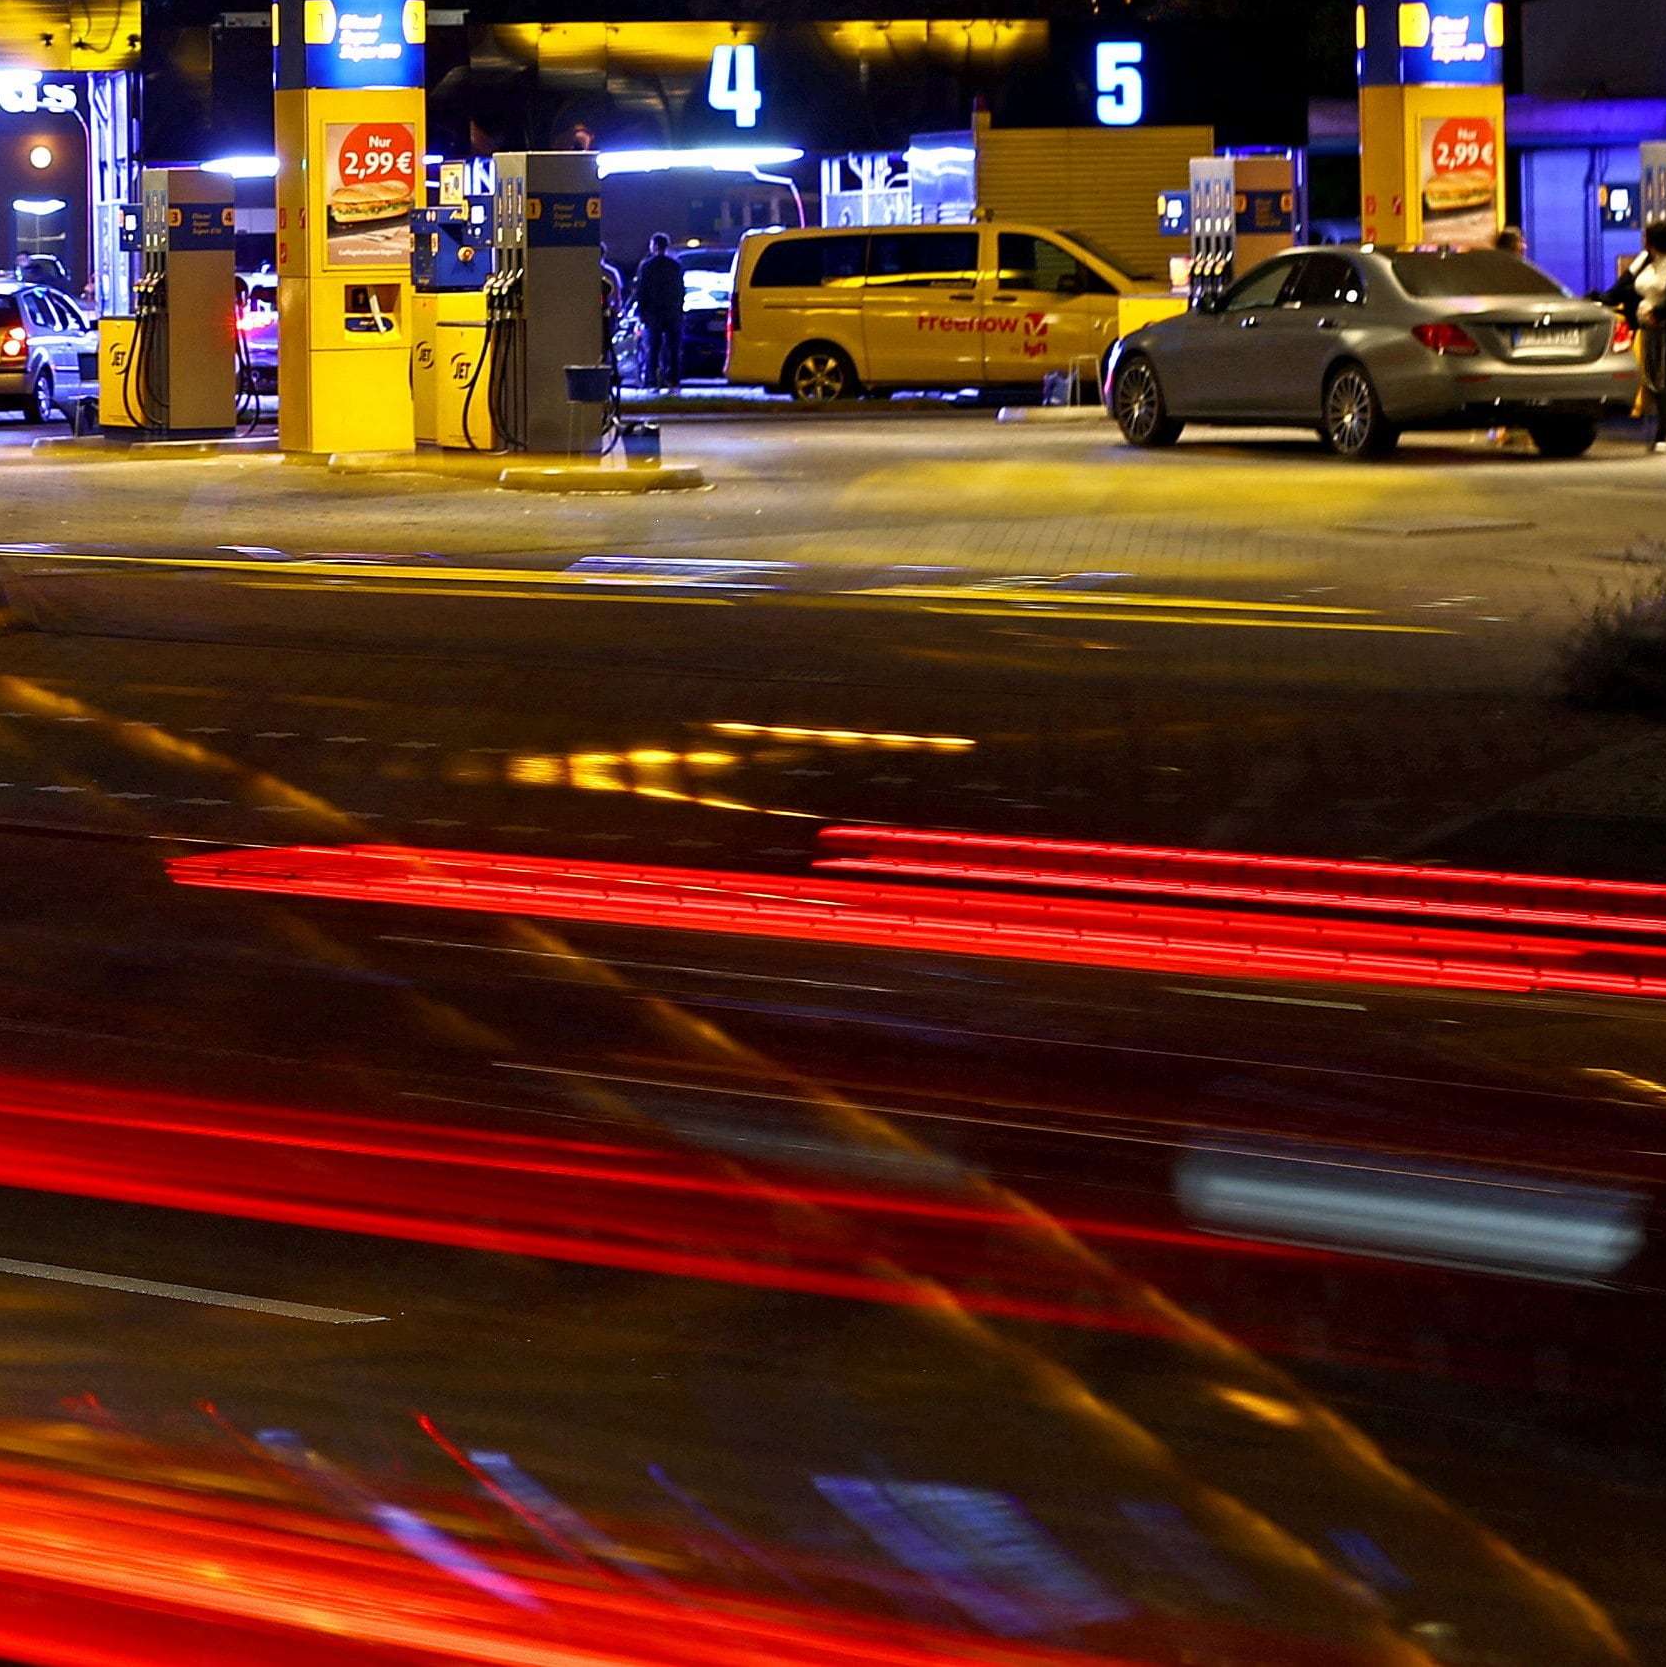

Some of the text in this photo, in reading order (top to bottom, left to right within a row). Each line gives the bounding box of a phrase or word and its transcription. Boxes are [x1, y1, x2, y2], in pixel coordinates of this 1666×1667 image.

[709, 45, 762, 128] 4
[1096, 41, 1143, 125] 5
[369, 135, 392, 148] Nur
